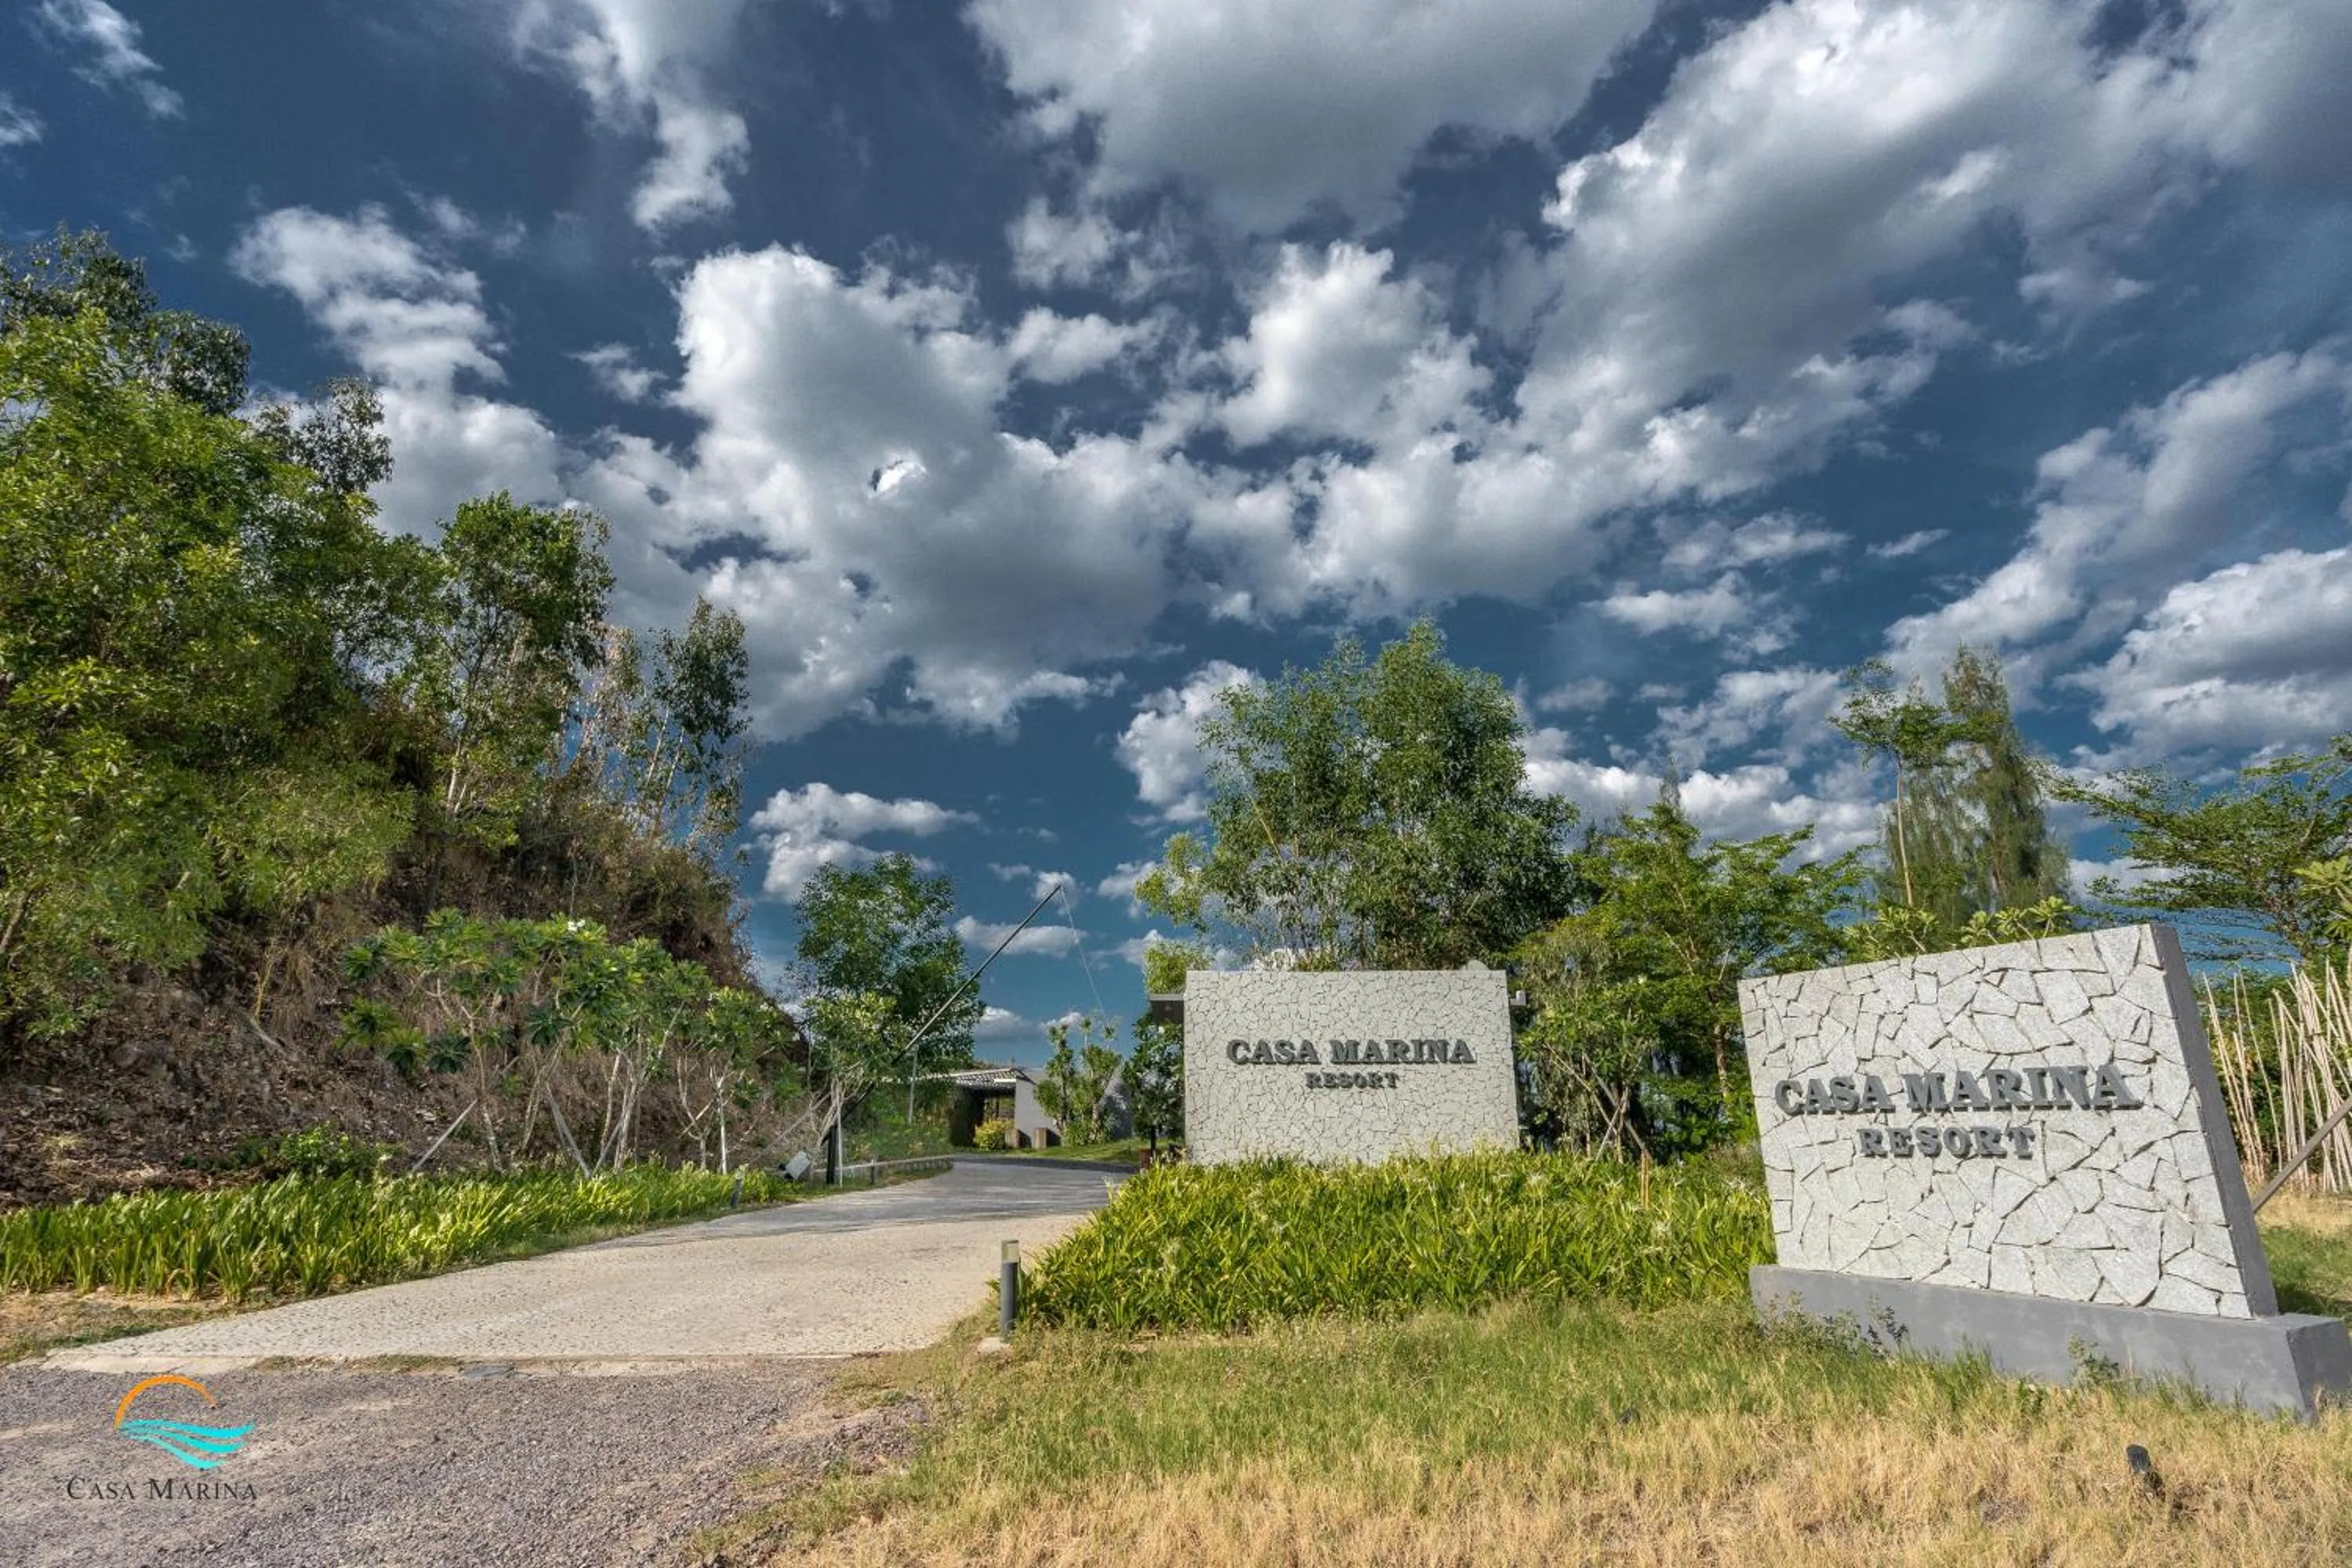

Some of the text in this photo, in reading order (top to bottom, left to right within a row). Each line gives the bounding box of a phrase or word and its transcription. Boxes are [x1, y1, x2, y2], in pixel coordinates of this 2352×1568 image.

[1226, 1039, 1476, 1065] CASA MARINA
[1305, 1071, 1399, 1089] RESORT
[1774, 1064, 2143, 1116] CASA MARINA
[1856, 1125, 2036, 1160] RESORT
